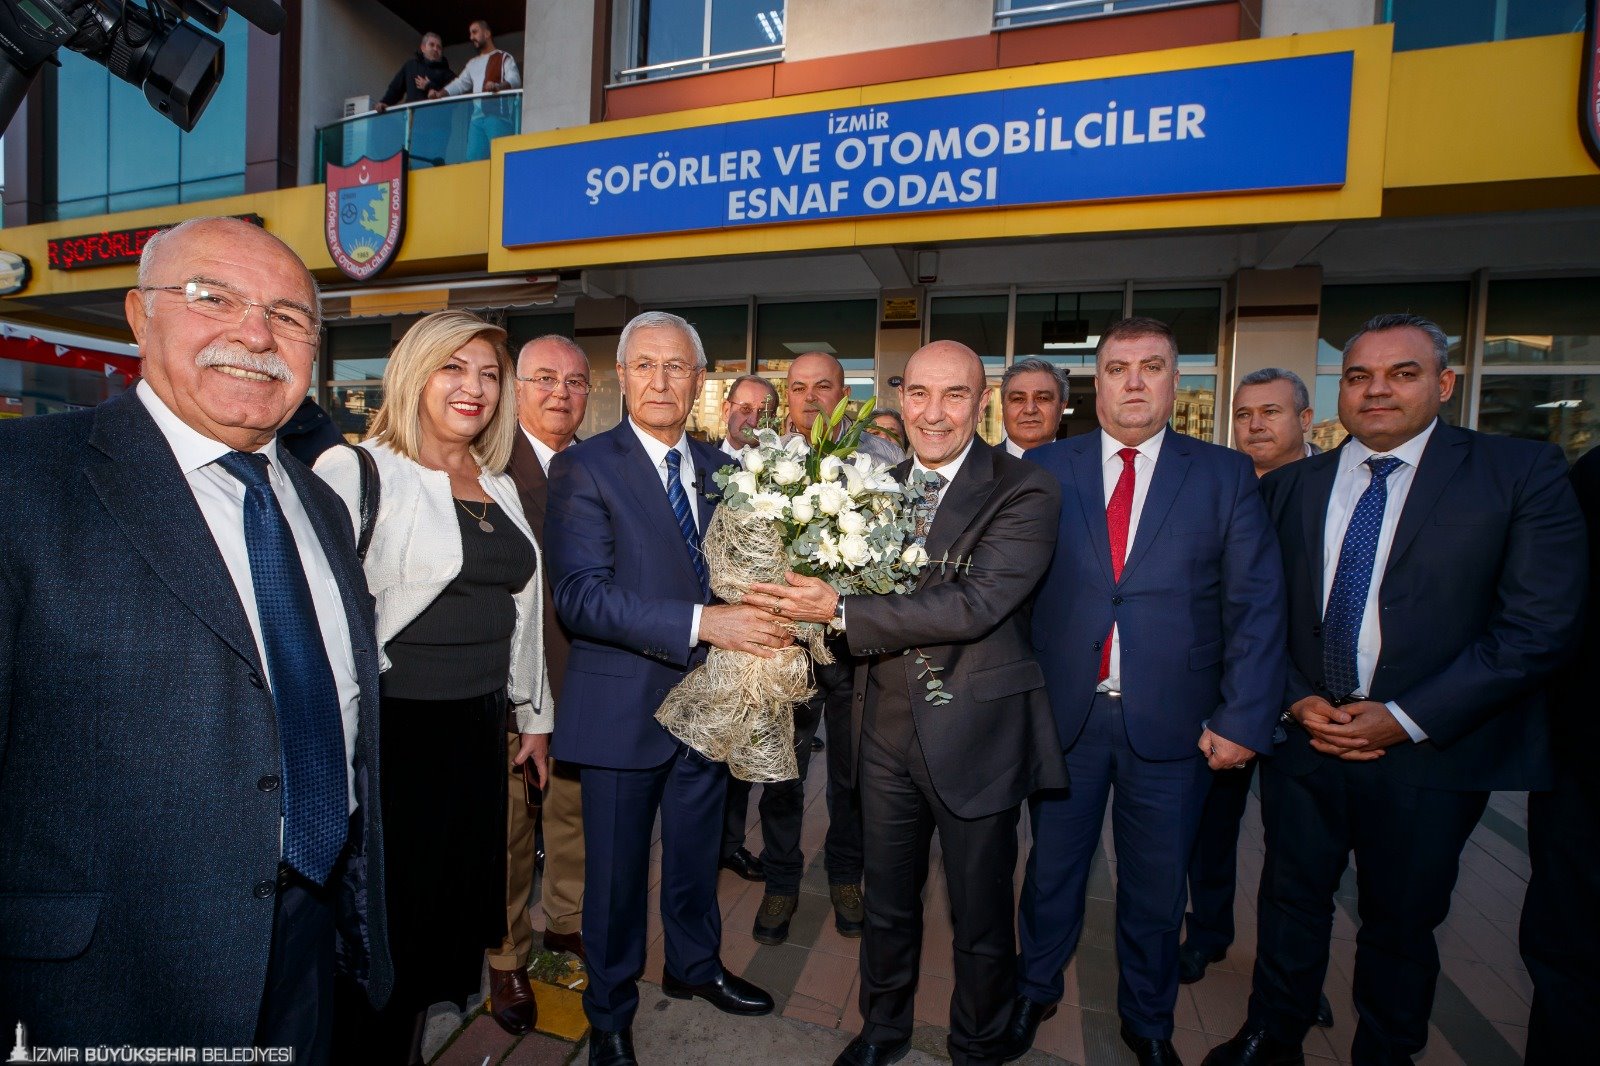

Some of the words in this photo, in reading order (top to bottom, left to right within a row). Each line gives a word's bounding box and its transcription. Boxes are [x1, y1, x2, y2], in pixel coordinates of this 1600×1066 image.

[828, 108, 889, 134] İZMİR
[585, 150, 761, 205] ŞOFÖRLER
[773, 142, 821, 176] VE
[835, 101, 1206, 170] OTOMOBİLCİLER
[392, 178, 400, 211] ODASI
[728, 180, 849, 221] ESNAF
[863, 167, 997, 209] ODASI
